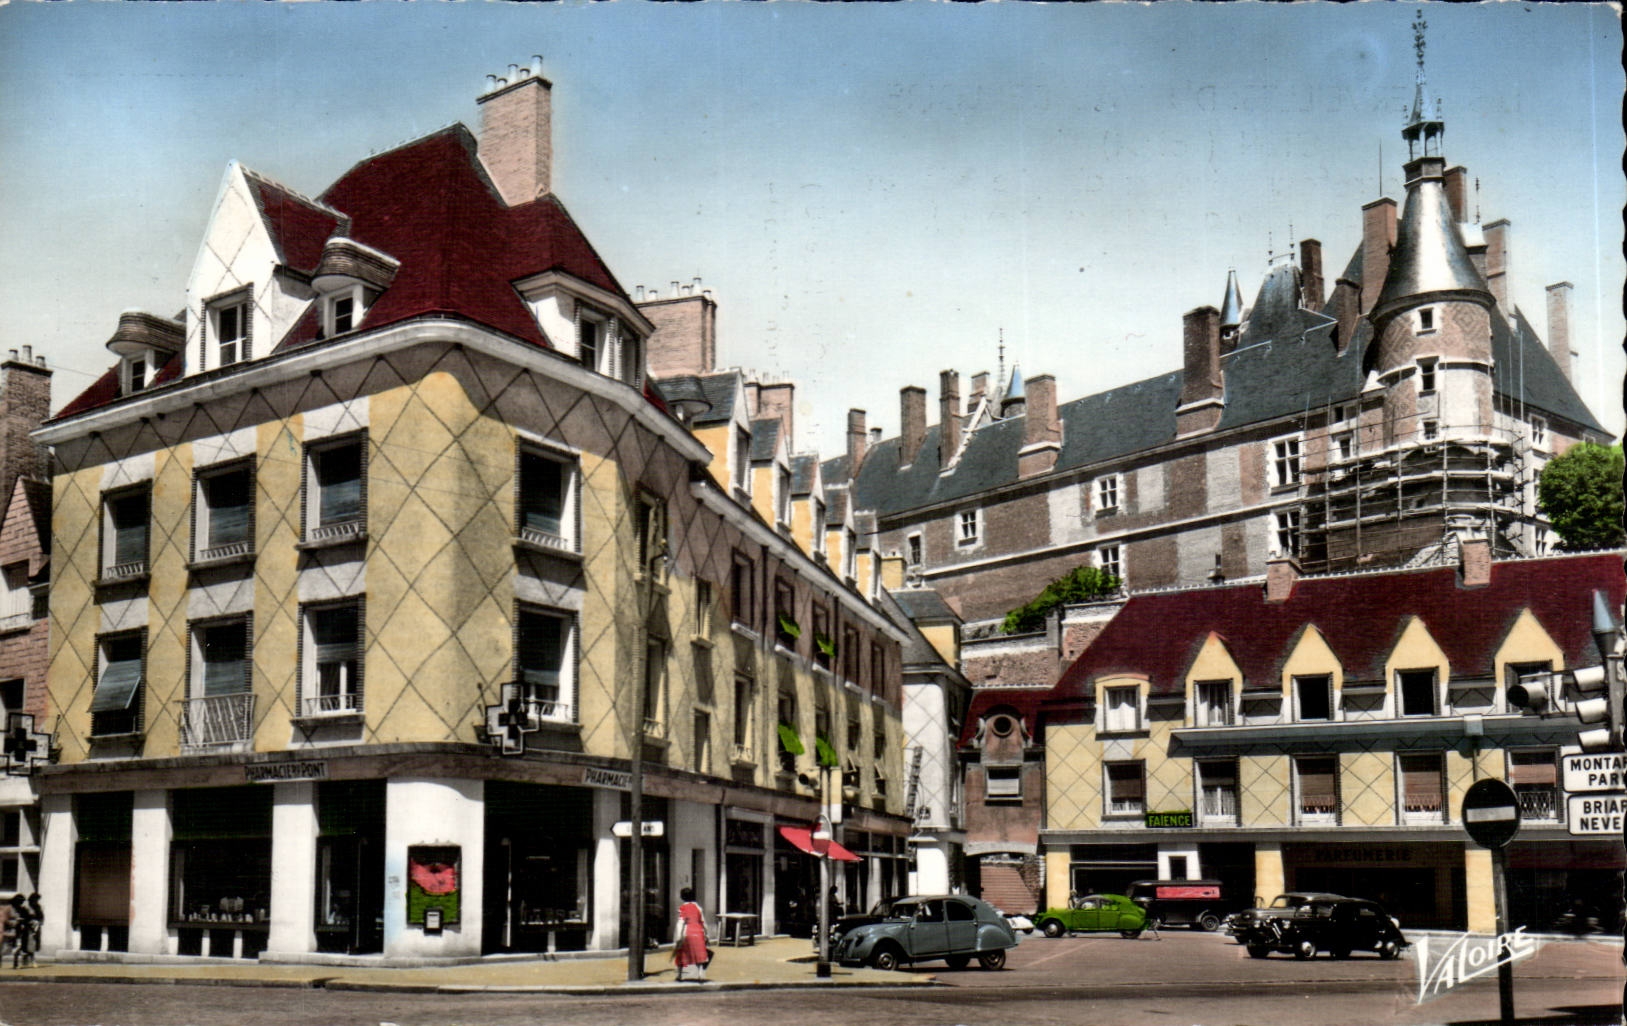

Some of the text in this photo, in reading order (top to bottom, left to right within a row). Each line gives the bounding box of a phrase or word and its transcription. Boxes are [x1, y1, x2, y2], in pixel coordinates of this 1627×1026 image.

[245, 764, 292, 780] PHARMACIE
[301, 761, 325, 778] PONT
[1580, 816, 1621, 831] NEVE
[1315, 848, 1410, 861] PARFUMERIE
